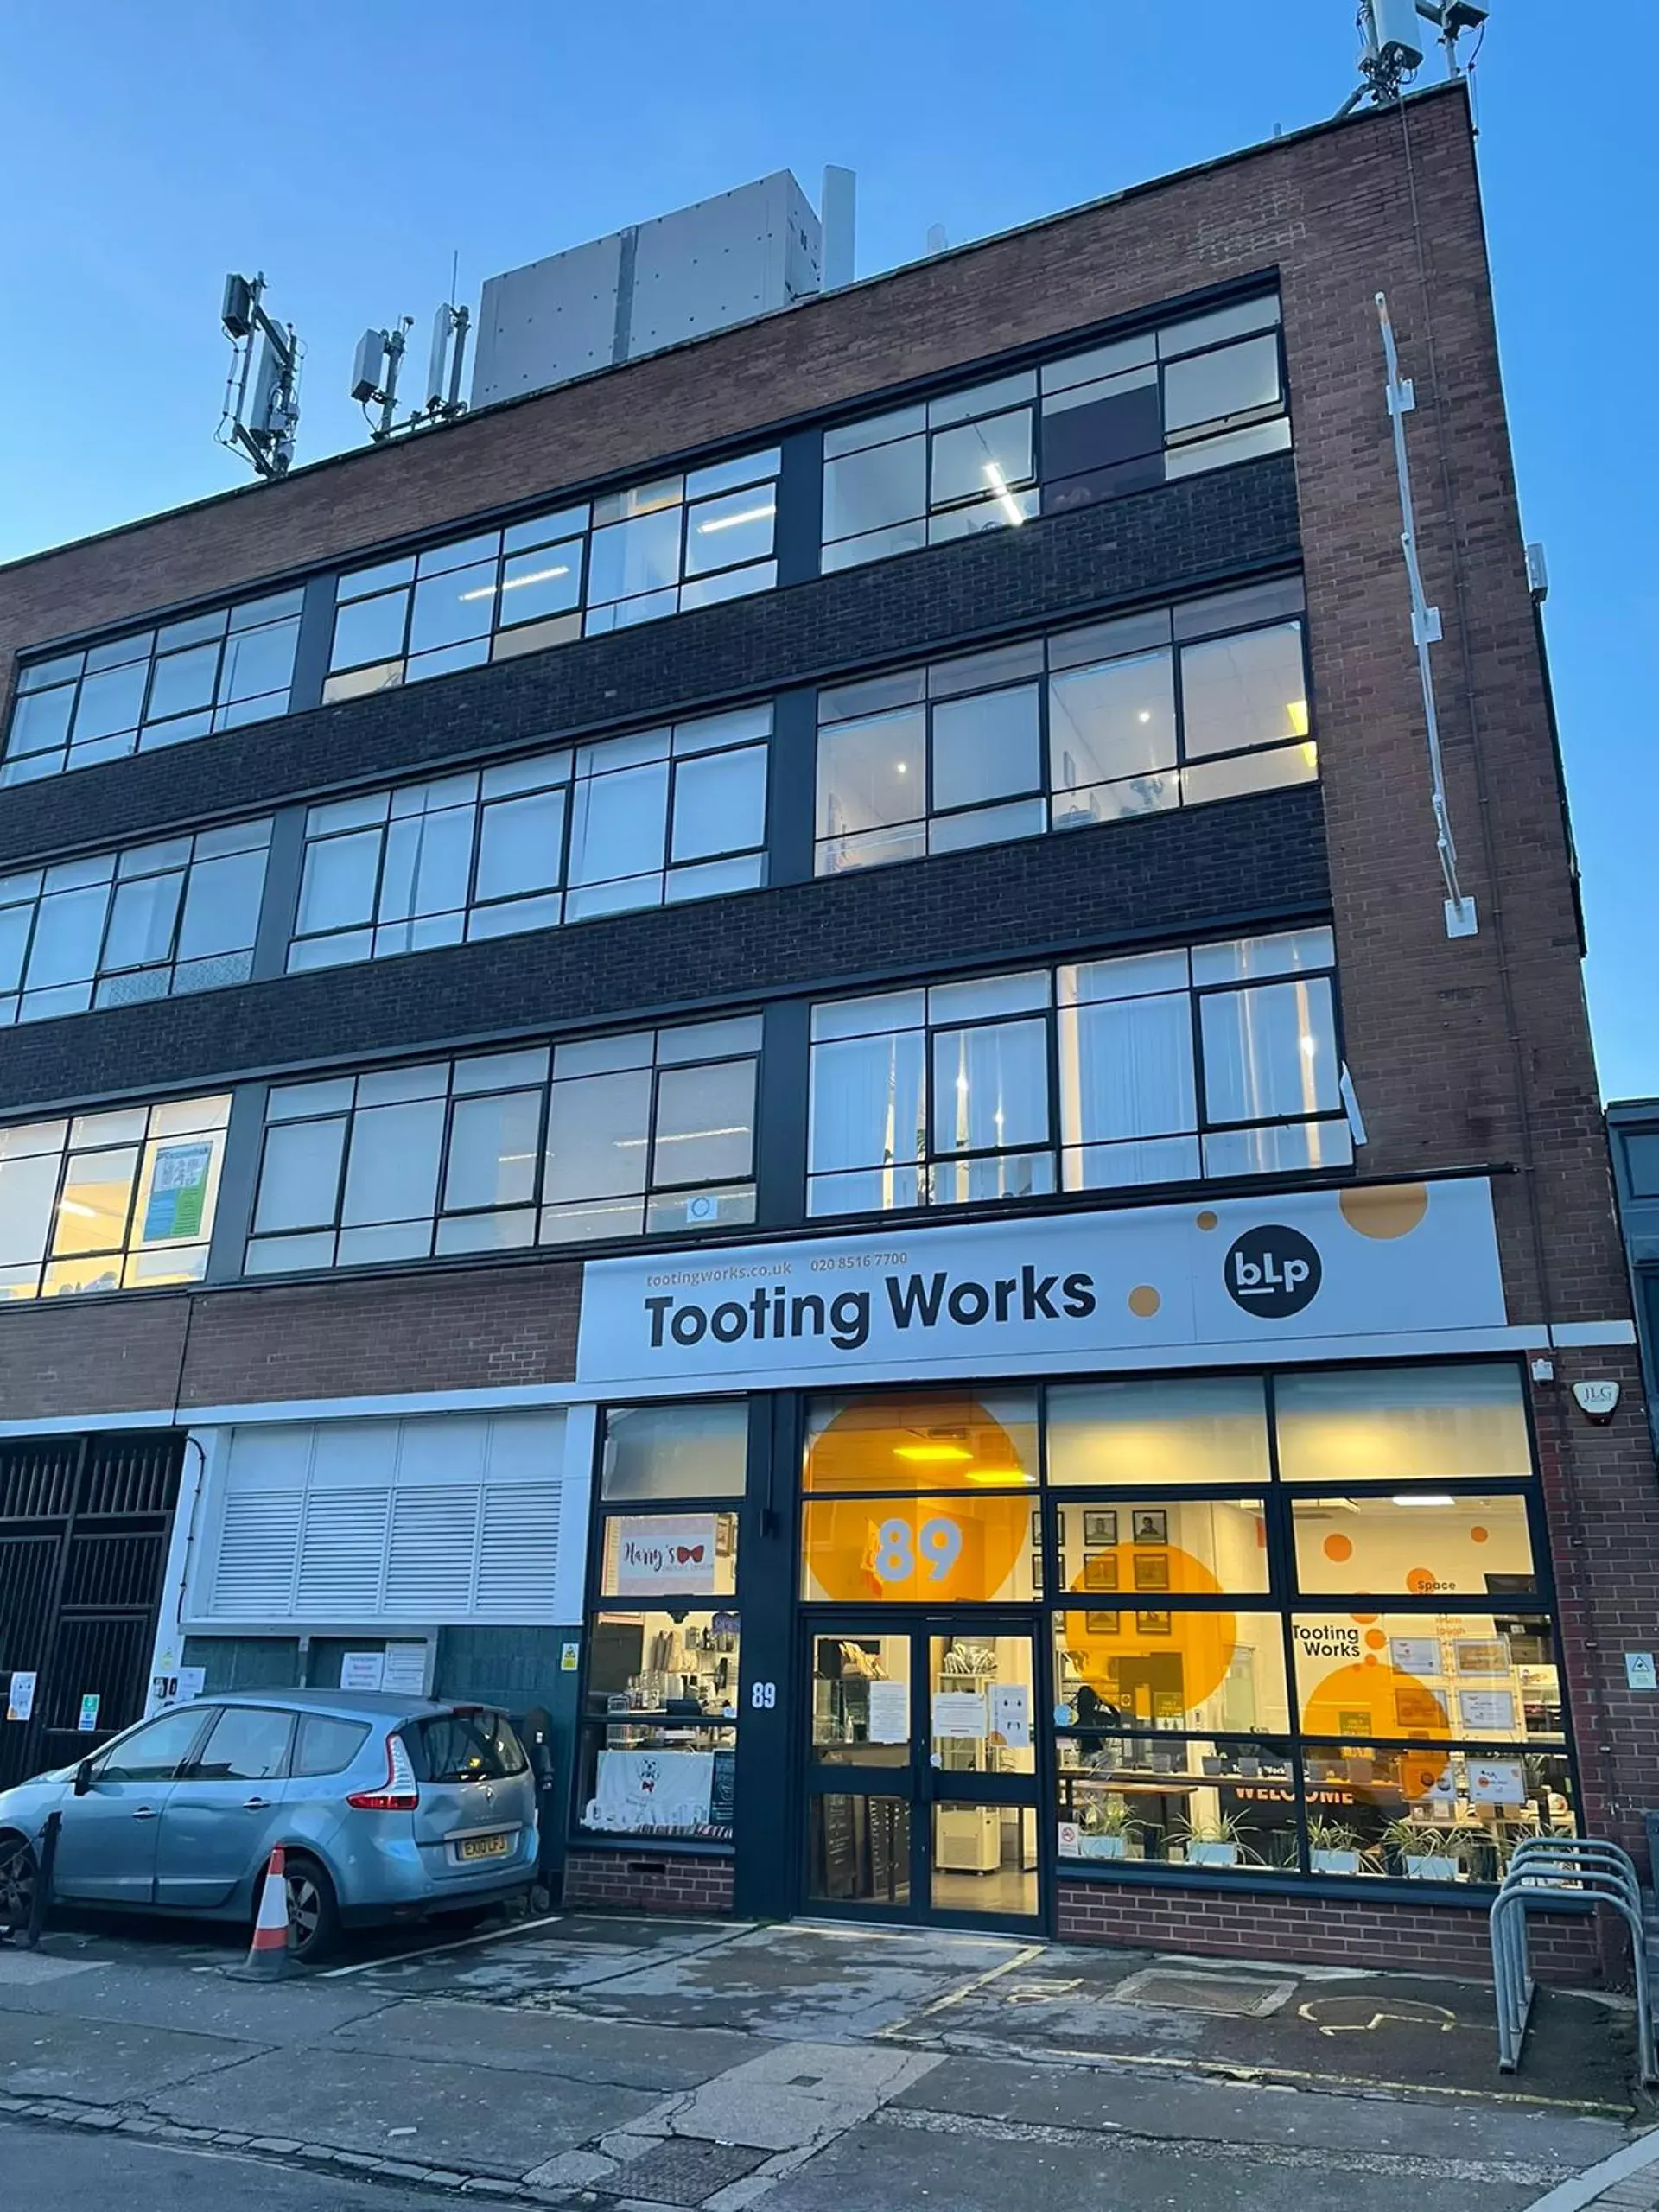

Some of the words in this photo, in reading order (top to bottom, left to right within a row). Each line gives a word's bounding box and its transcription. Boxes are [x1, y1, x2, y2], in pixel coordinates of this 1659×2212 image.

[646, 1261, 791, 1288] tootingworks.co.uk
[810, 1259, 836, 1272] 020
[837, 1255, 870, 1269] 8516
[874, 1252, 908, 1267] 7700
[645, 1285, 870, 1350] Tooting
[885, 1265, 1096, 1330] Works
[874, 1518, 963, 1582] 89
[1417, 1580, 1457, 1592] Space
[1293, 1624, 1359, 1643] Tooting
[1304, 1643, 1361, 1657] Works
[752, 1682, 775, 1708] 89
